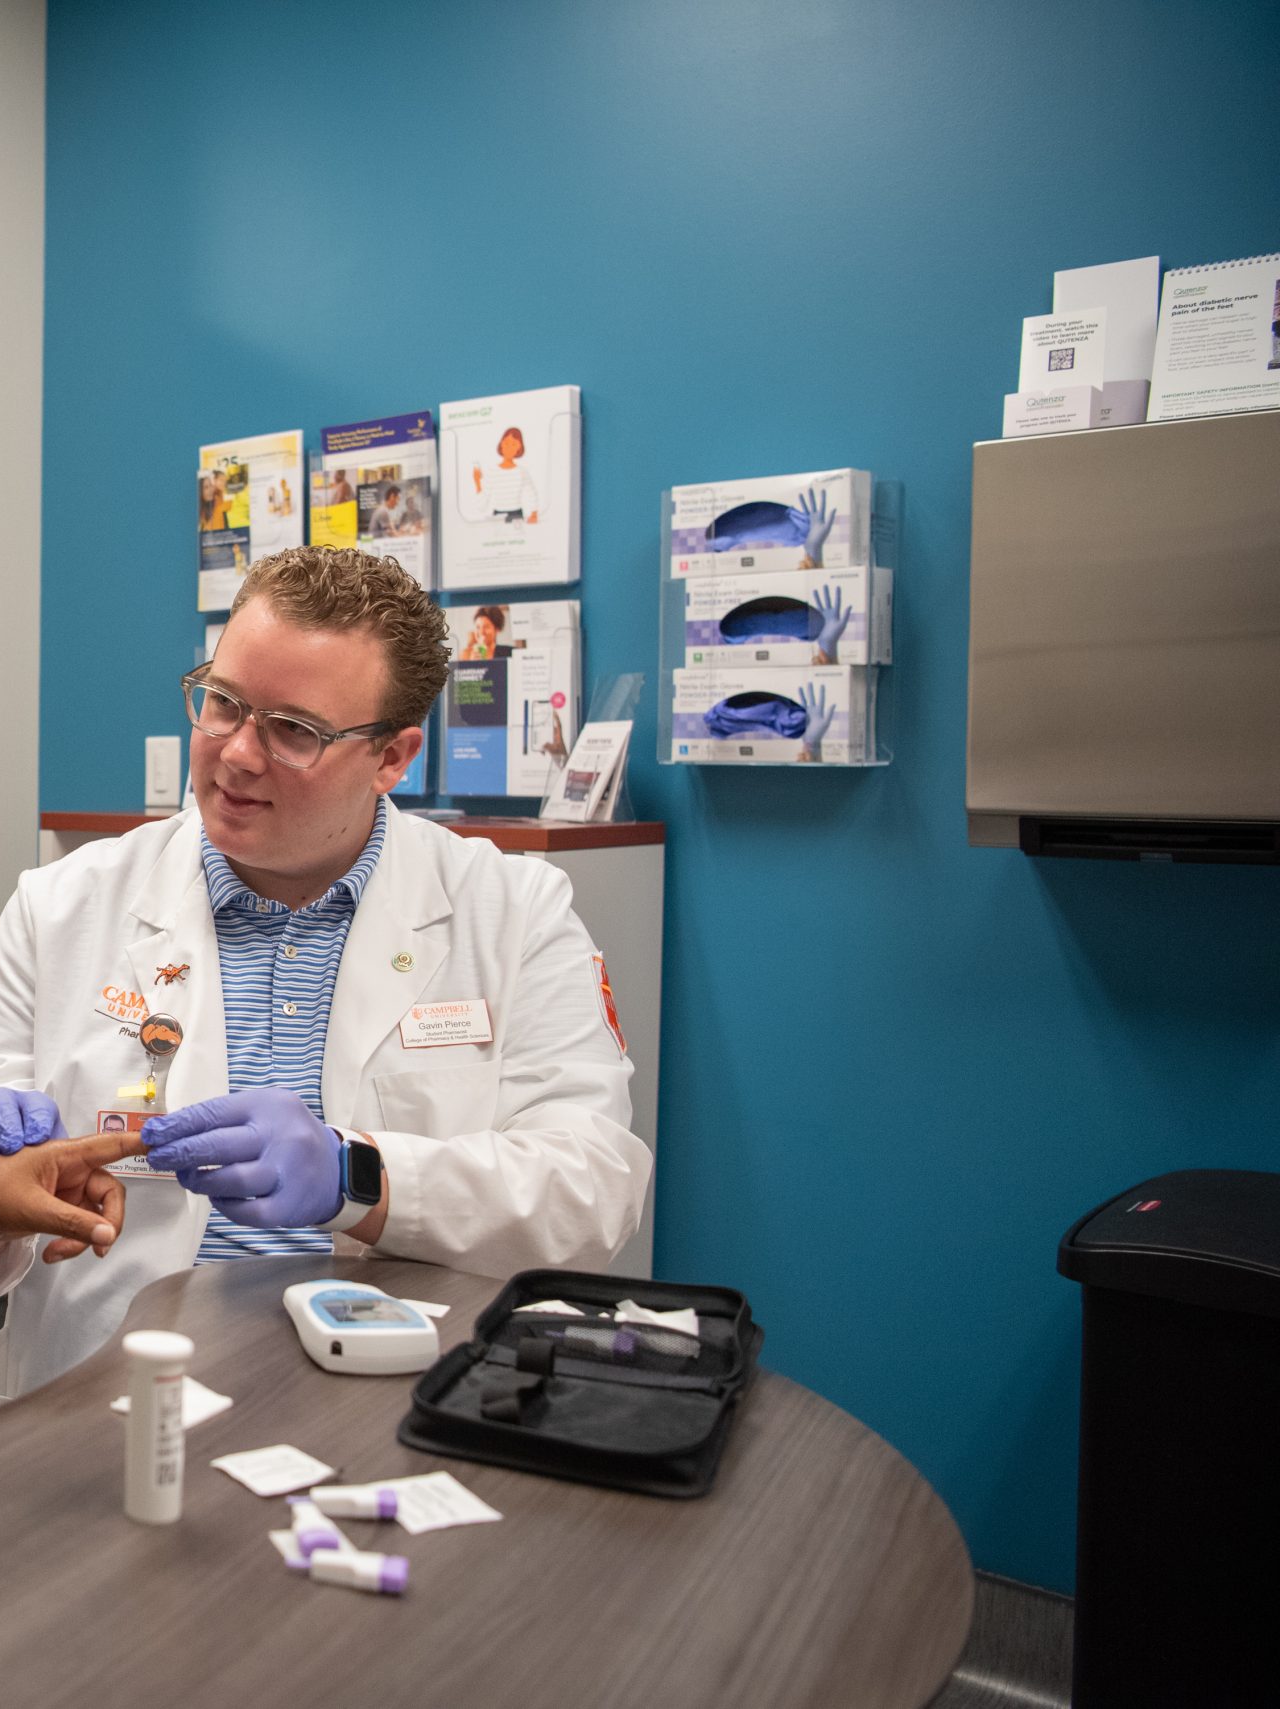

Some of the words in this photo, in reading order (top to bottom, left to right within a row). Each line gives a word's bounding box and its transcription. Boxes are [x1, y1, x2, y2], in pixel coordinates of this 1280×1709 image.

[1172, 301, 1197, 310] About
[1199, 297, 1233, 307] diabetic
[1234, 293, 1259, 301] nerve
[1171, 308, 1190, 318] pain
[1217, 303, 1234, 311] feet
[1068, 319, 1084, 327] your
[1032, 334, 1050, 342] video
[1057, 335, 1089, 345] QUTENZA
[1026, 395, 1066, 408] Qutenza
[102, 985, 146, 1009] CAM
[423, 1004, 473, 1015] CAMPBELL
[418, 1022, 443, 1031] Gavin
[444, 1020, 472, 1029] Pierce
[118, 1026, 140, 1039] Phar
[124, 1164, 148, 1172] Program
